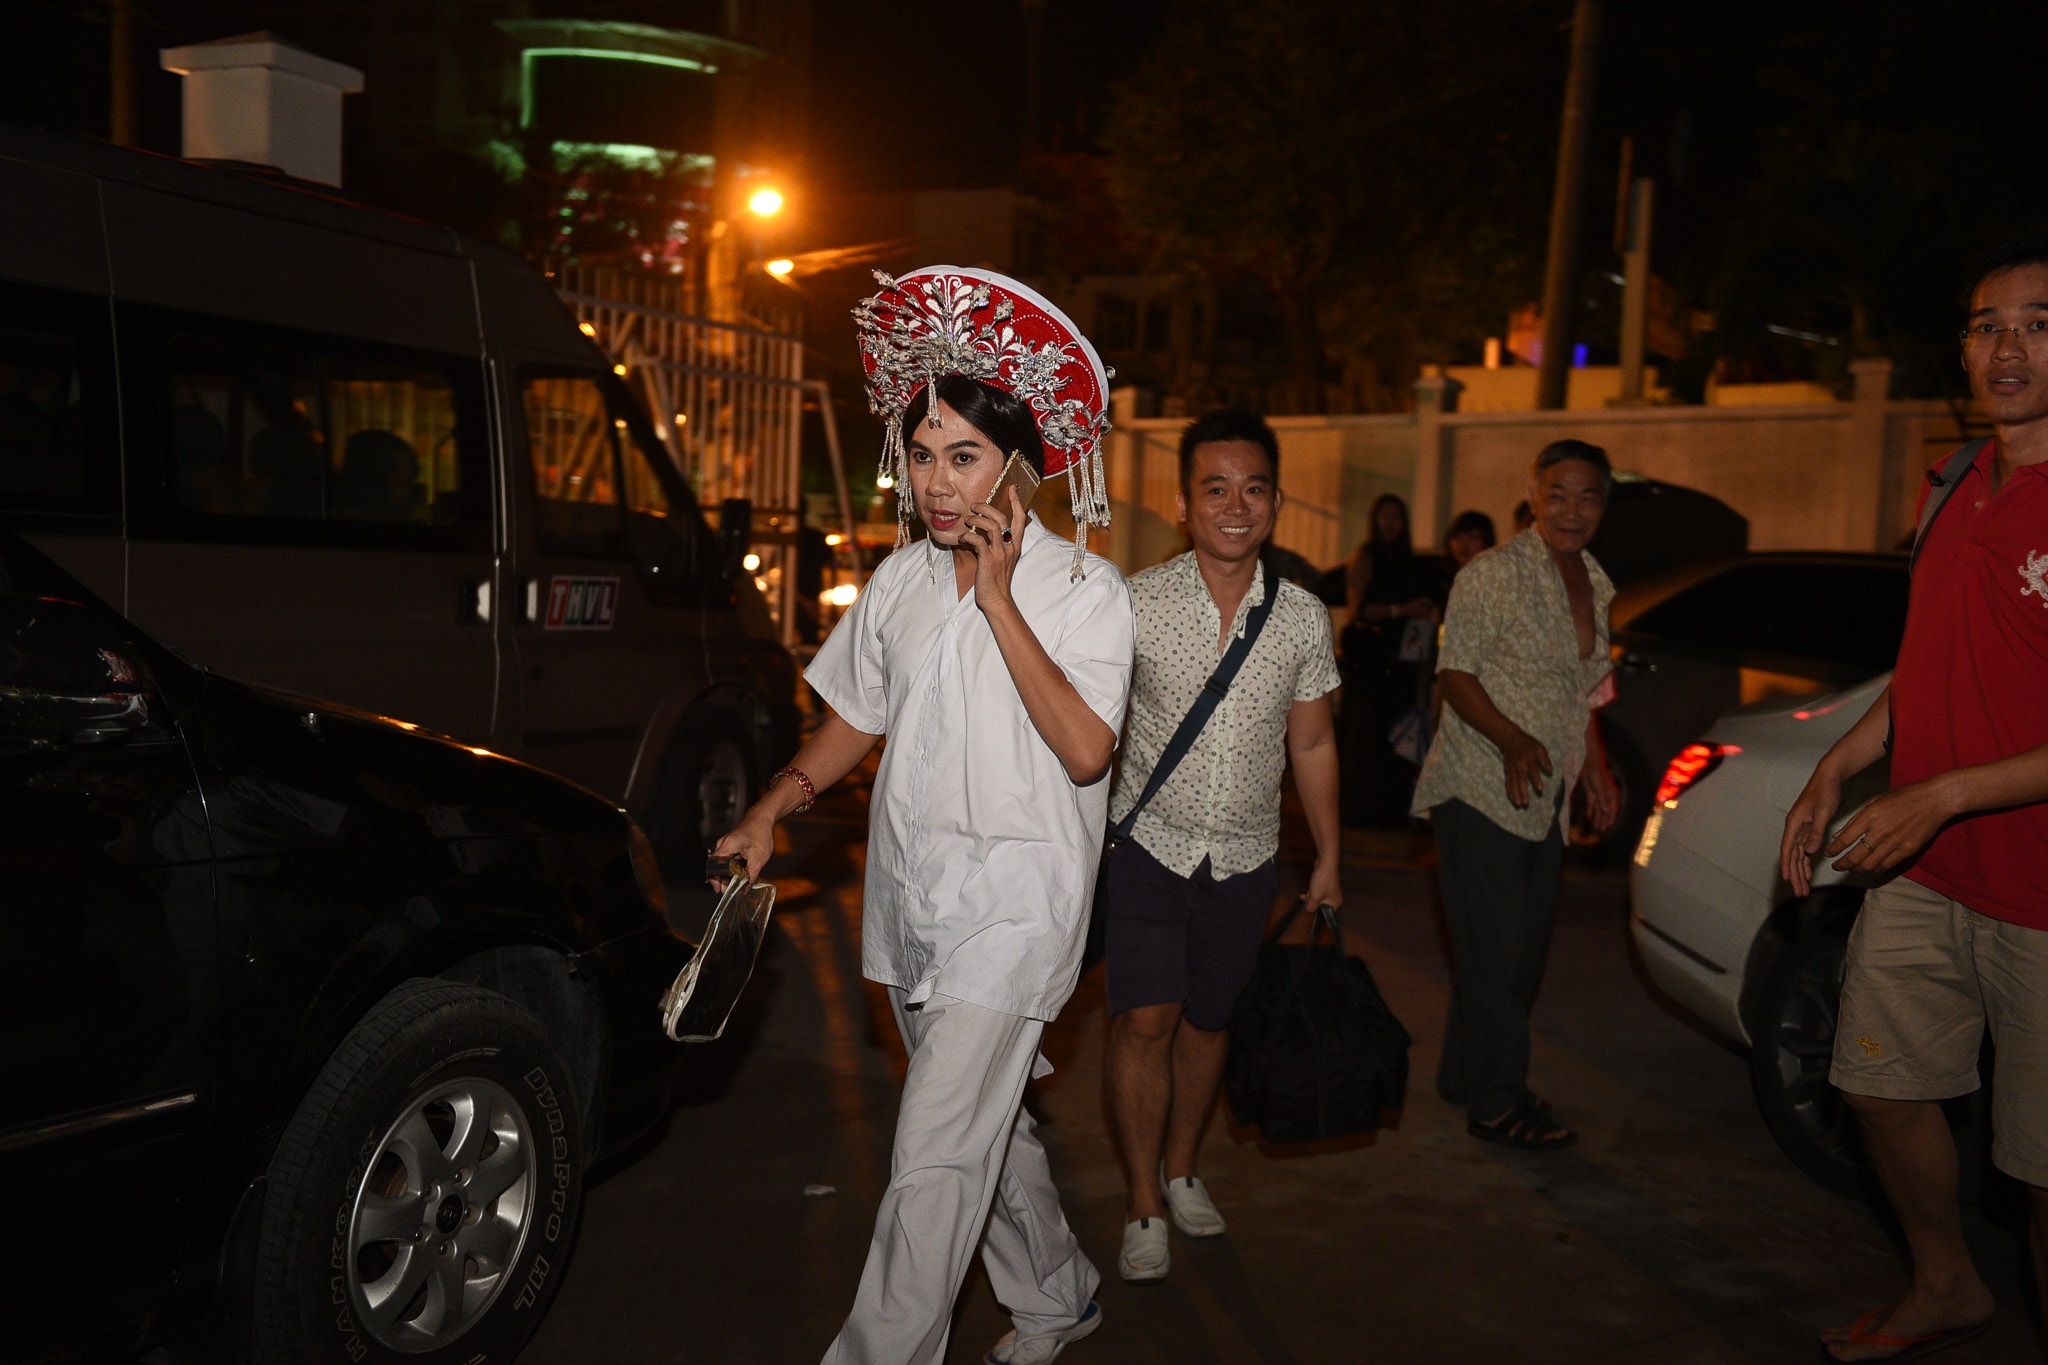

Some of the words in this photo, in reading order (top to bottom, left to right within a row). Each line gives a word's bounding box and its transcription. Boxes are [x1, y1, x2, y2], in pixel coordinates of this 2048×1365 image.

[549, 582, 614, 623] THVL
[331, 1128, 376, 1362] HANKOOK
[514, 1253, 550, 1311] HL
